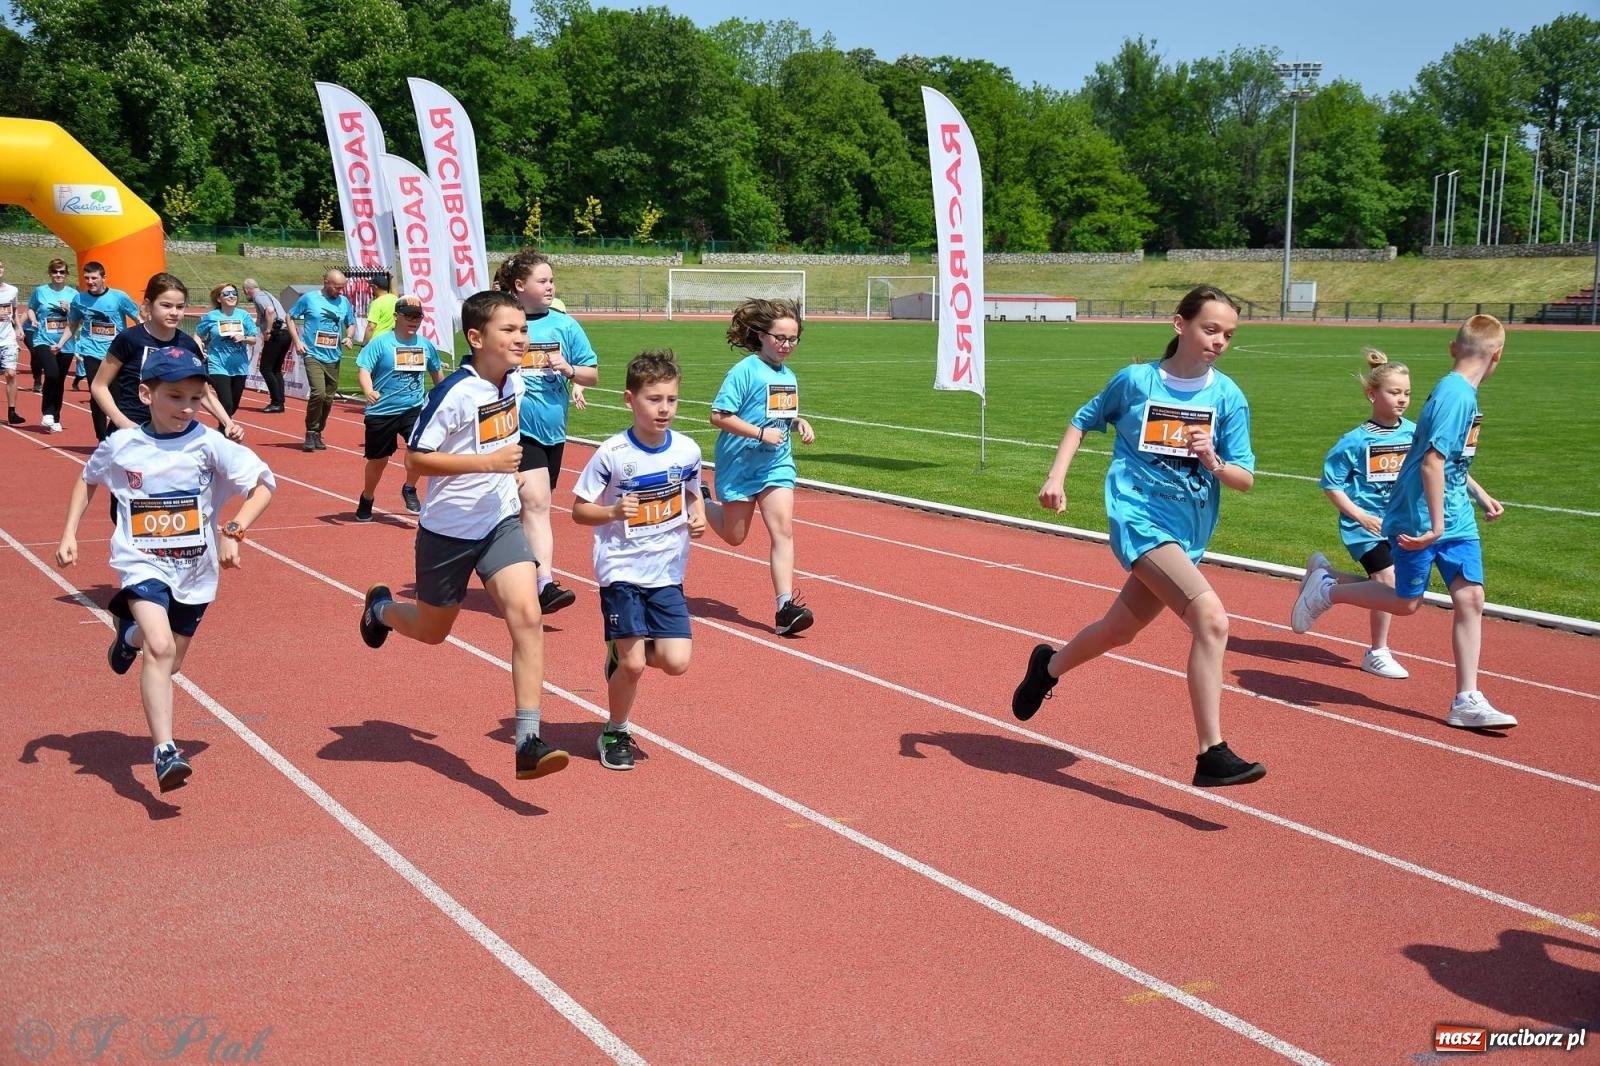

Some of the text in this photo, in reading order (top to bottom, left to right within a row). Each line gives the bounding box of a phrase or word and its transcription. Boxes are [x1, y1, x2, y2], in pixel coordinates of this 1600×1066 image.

[531, 353, 549, 366] 12
[494, 411, 514, 440] 110
[144, 513, 186, 532] 090
[644, 501, 672, 524] 114
